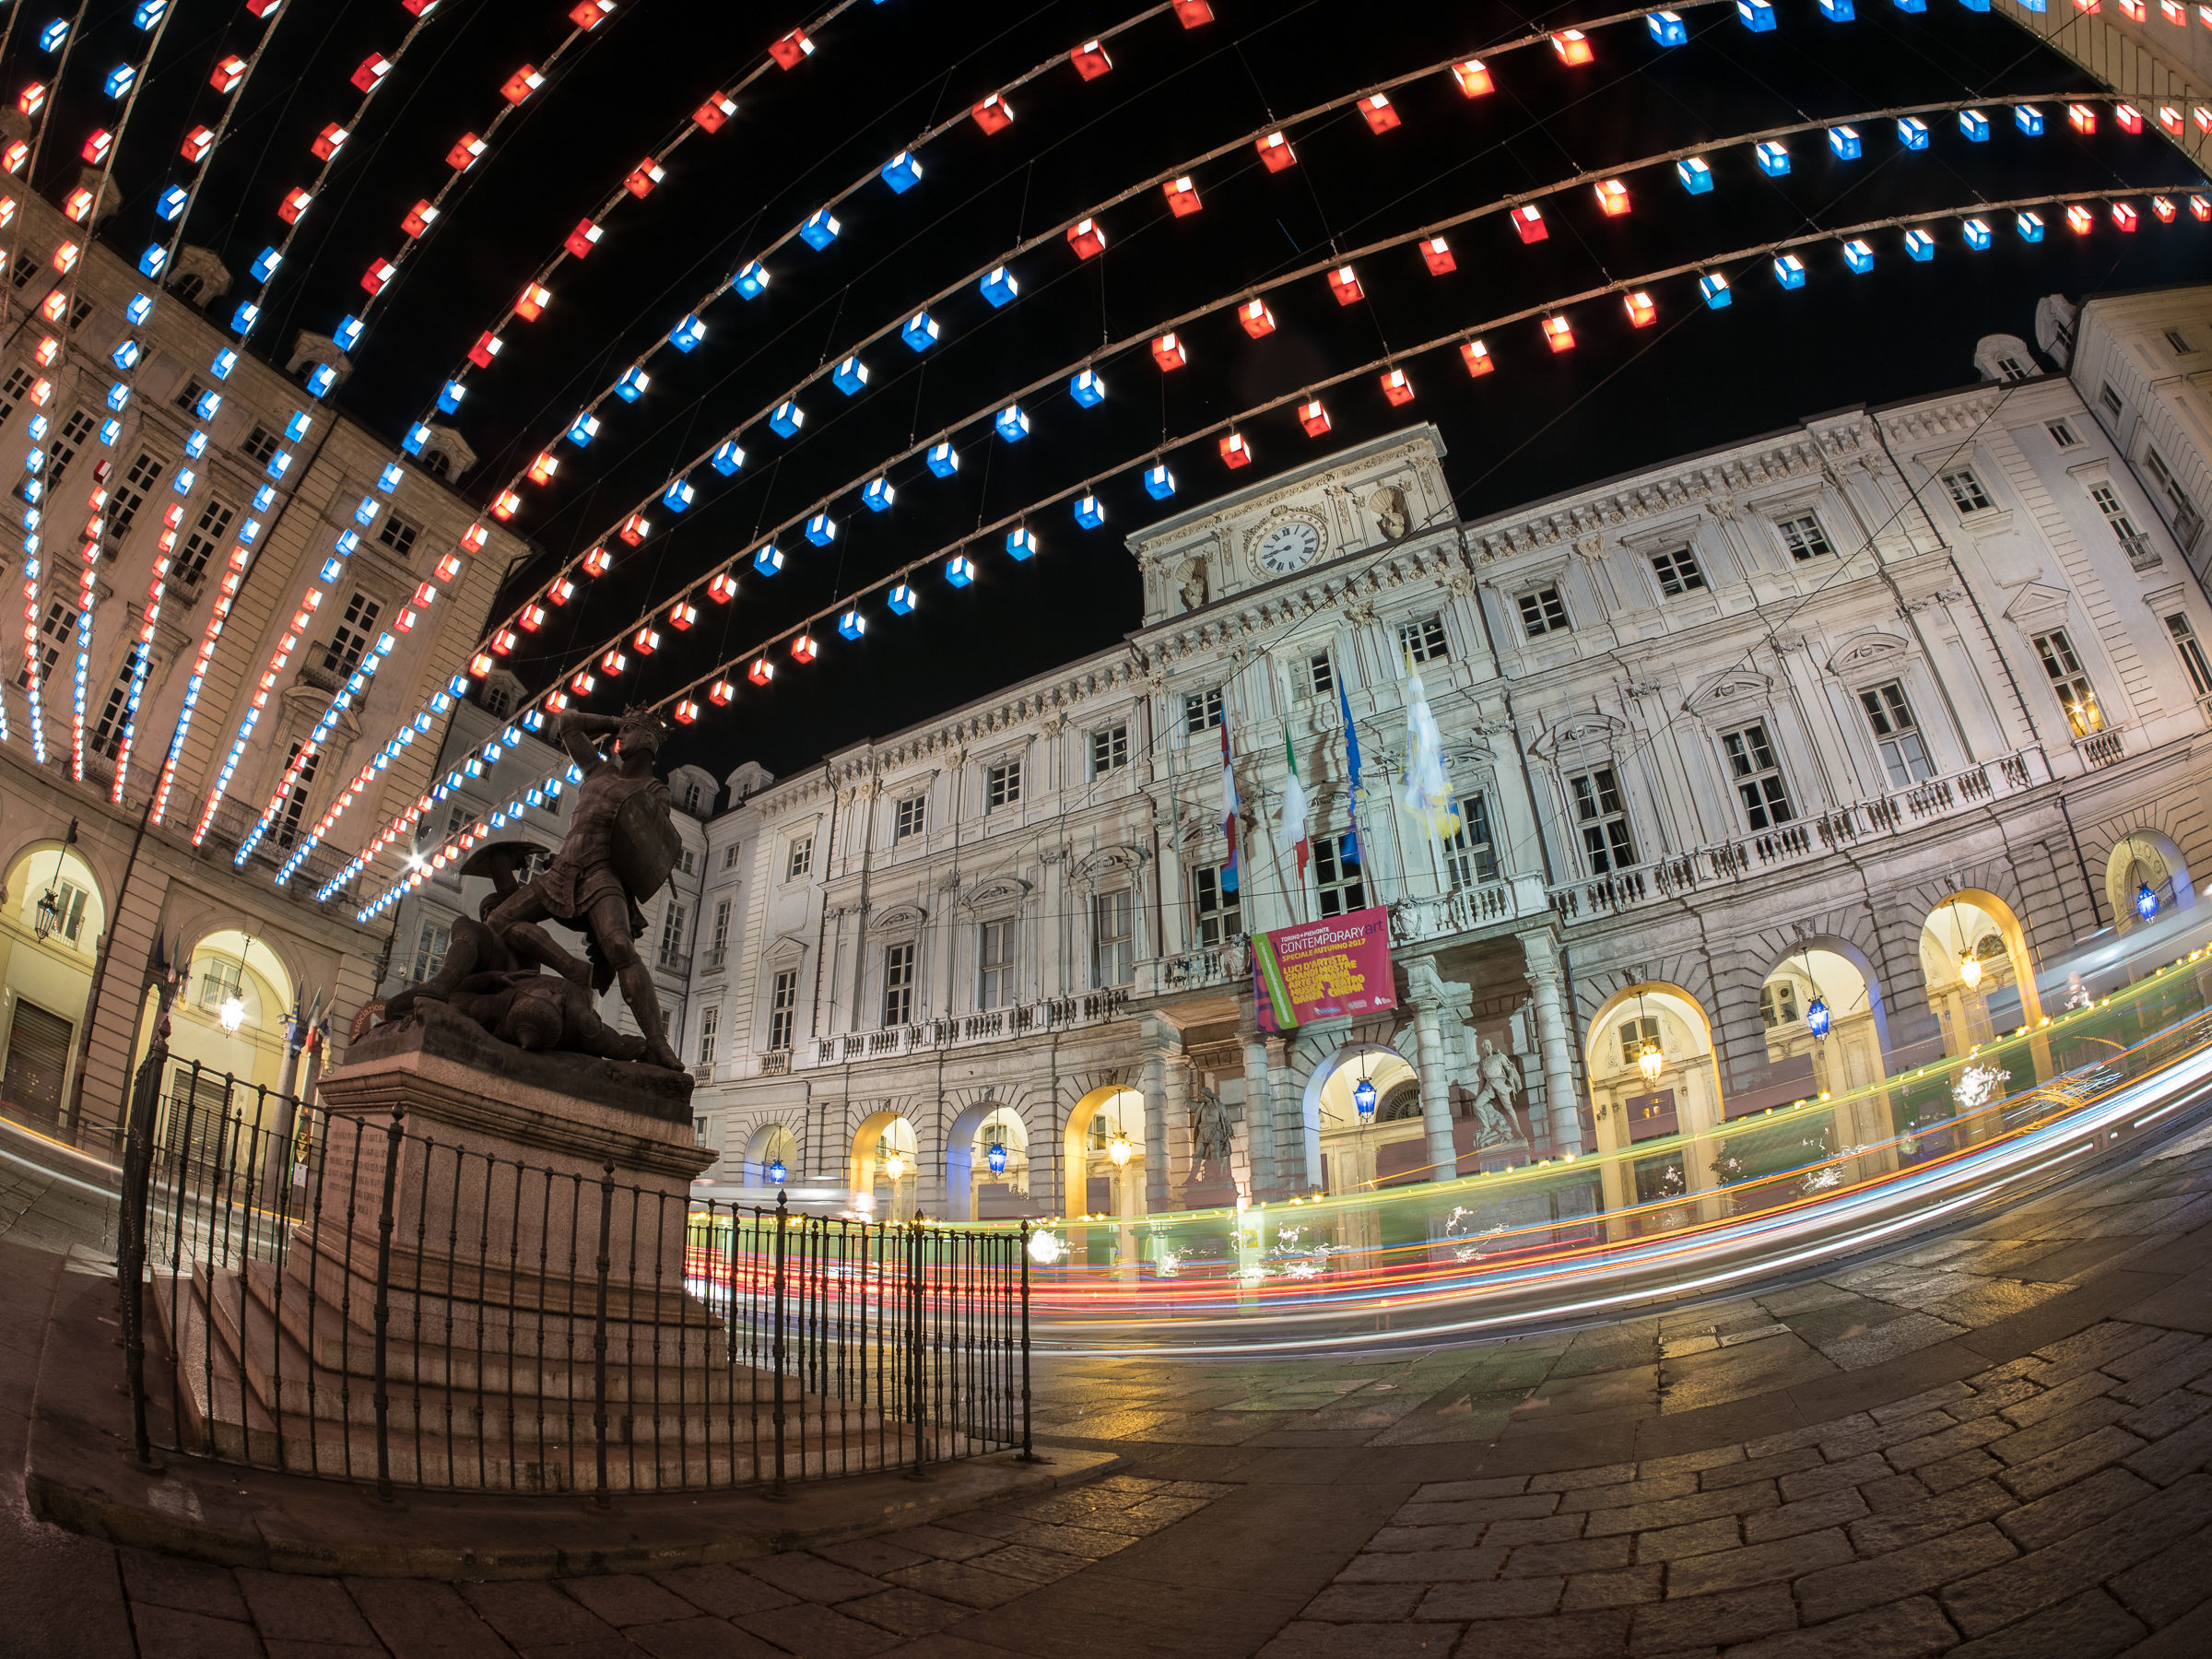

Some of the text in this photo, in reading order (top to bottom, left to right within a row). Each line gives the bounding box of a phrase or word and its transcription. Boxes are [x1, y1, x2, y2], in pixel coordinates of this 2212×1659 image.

[1282, 937, 1366, 962] SPECIALE AUTUNNO 2017
[1283, 953, 1349, 975] LUCI D'ARTISTA
[1285, 959, 1358, 982] GRANDI MOSTRE
[1288, 978, 1312, 990] ARTE
[351, 1005, 385, 1041] Associazion
